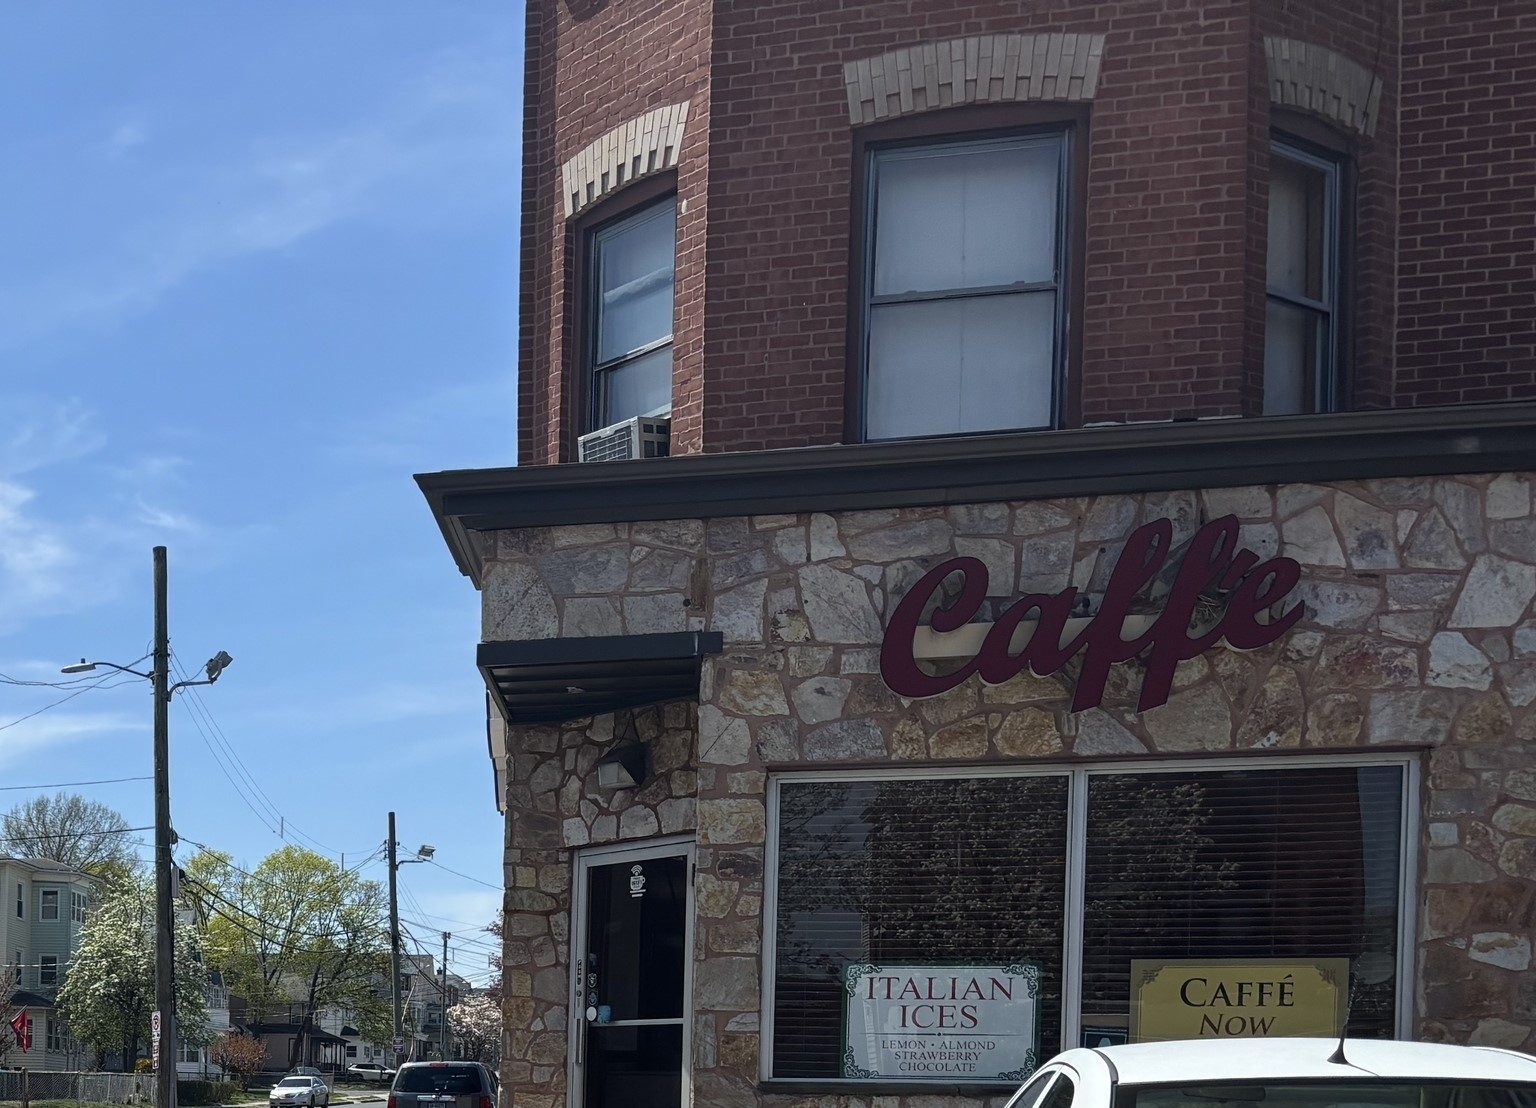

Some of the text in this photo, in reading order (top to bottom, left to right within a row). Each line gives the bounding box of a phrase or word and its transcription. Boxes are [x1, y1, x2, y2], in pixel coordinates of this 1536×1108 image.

[865, 976, 1016, 1001] ITALIAN
[1179, 974, 1295, 1007] CAFFÉ
[899, 1004, 979, 1029] ICES
[1199, 1013, 1277, 1036] NOW
[881, 1040, 996, 1051] LEMON ALMOND
[894, 1051, 982, 1061] STRAWBERRY
[898, 1062, 977, 1072] CHOCOLATE
